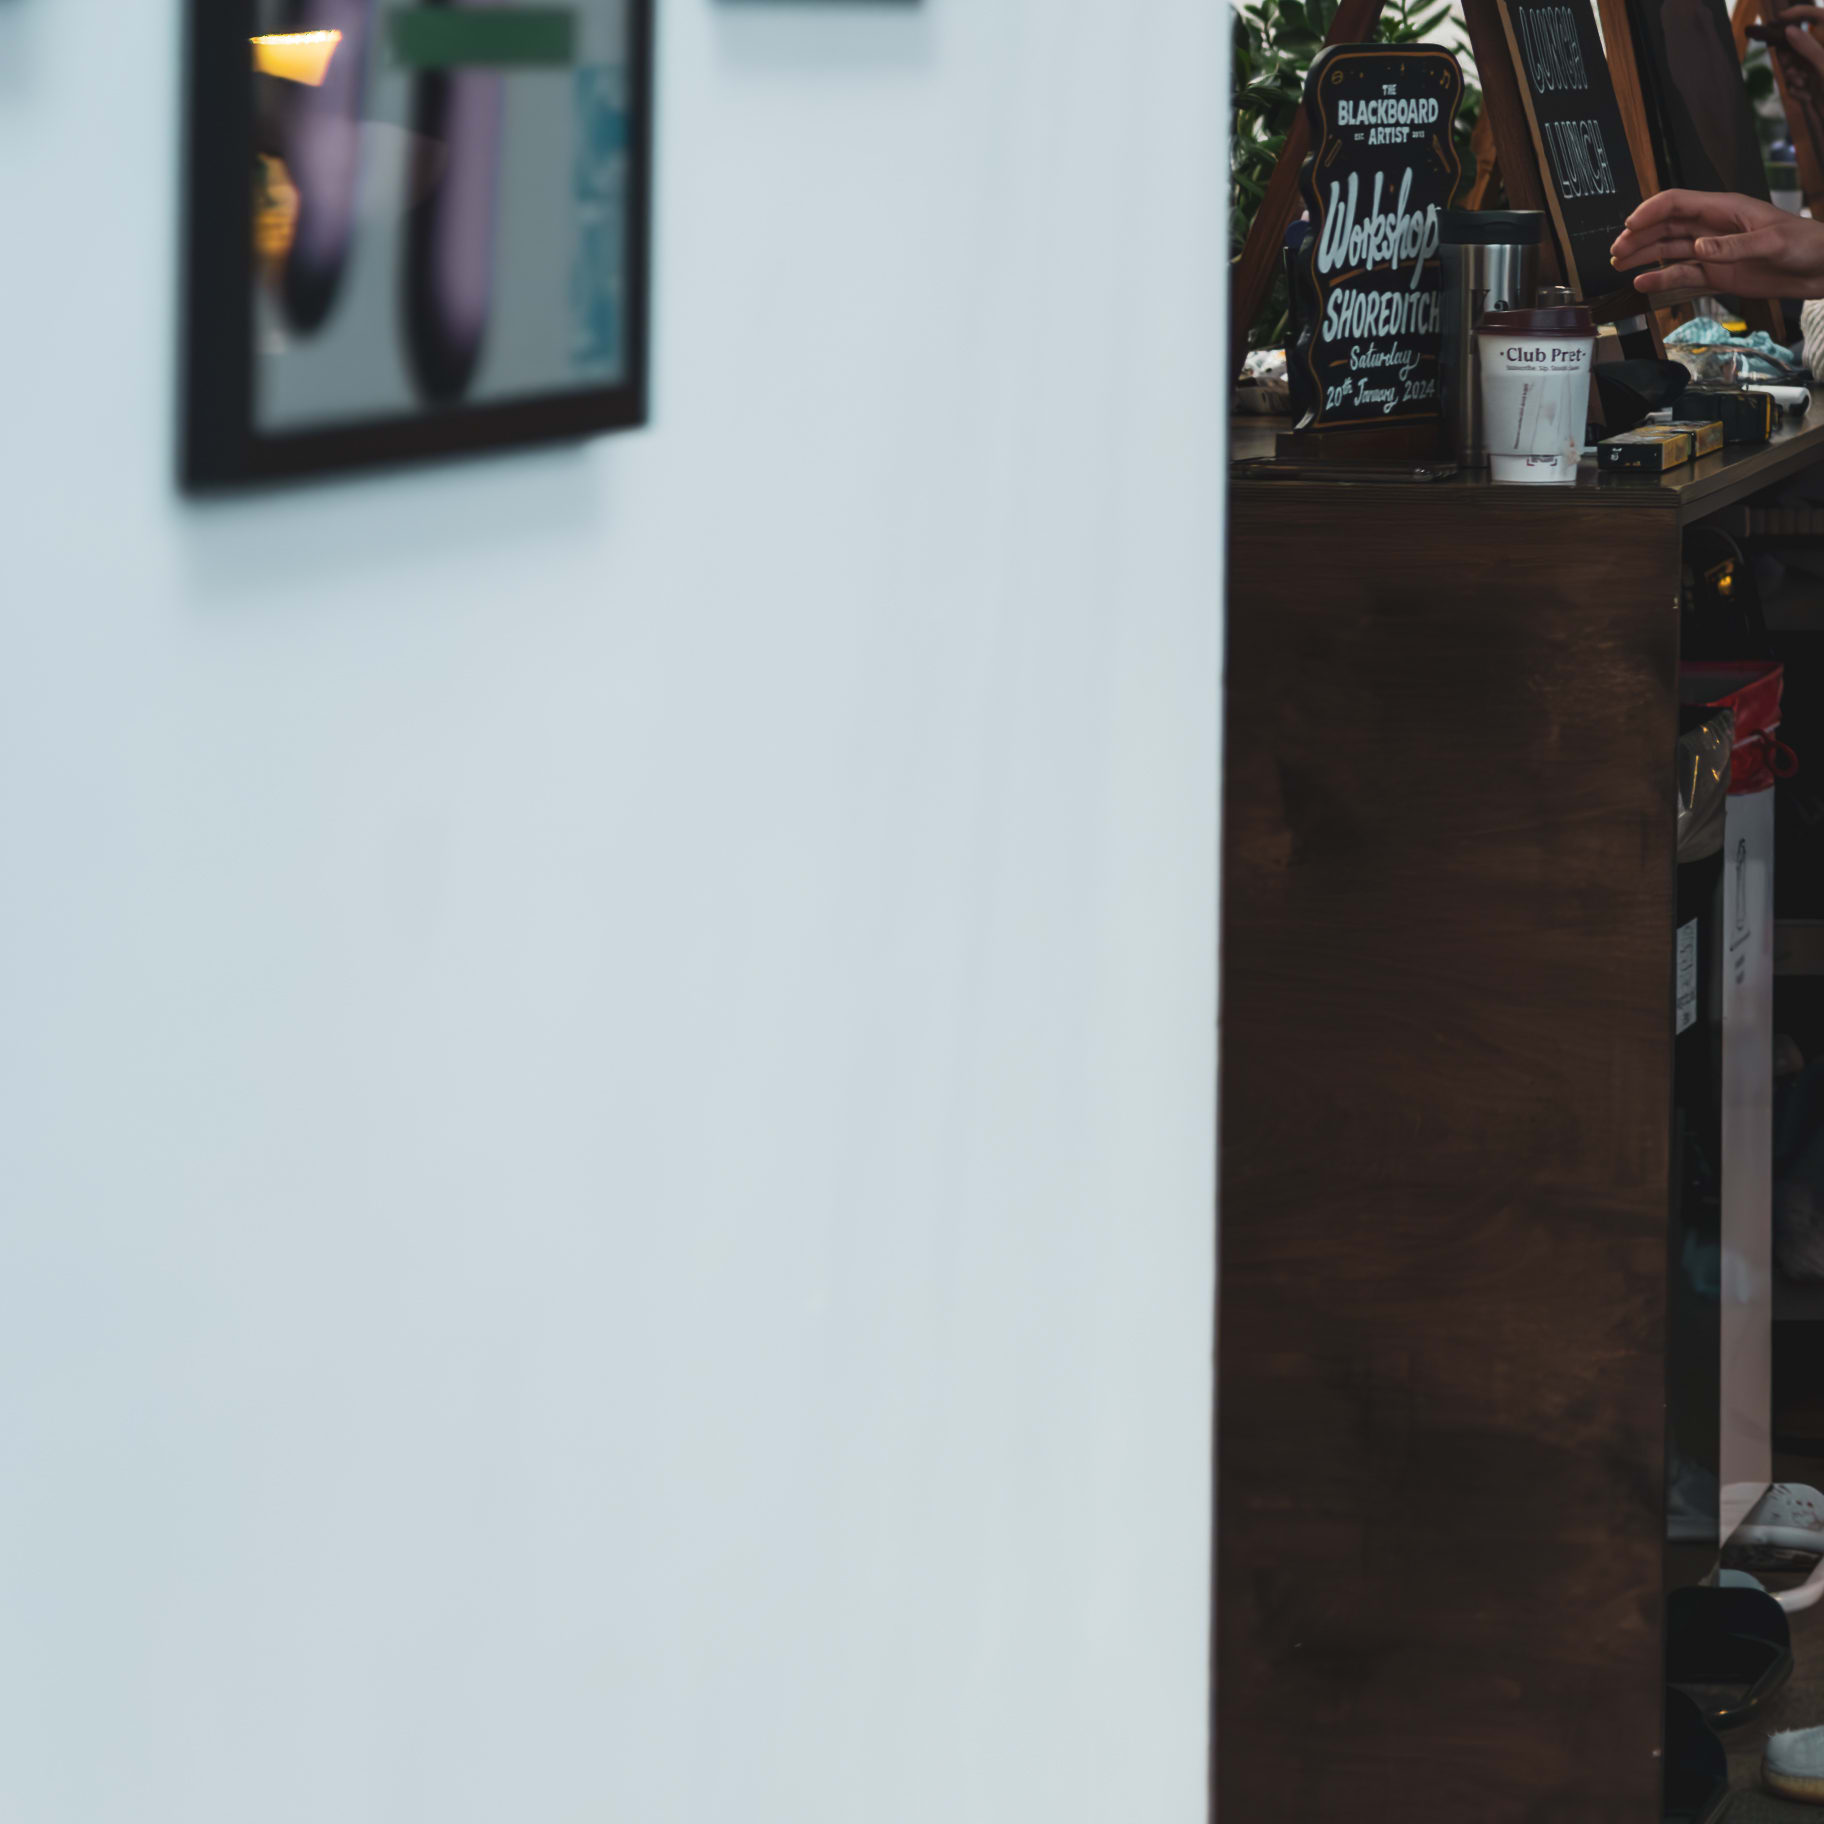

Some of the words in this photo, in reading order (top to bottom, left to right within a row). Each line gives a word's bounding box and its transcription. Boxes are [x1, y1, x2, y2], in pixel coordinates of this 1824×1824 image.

[1382, 83, 1398, 96] THE
[1337, 97, 1440, 126] BLACKBOARD
[1368, 126, 1411, 146] ARTIST
[1544, 120, 1616, 199] LUNCH
[1317, 166, 1441, 290] Workshop
[1322, 287, 1441, 343] SHOREDITCH
[1350, 341, 1421, 382] Saturday
[1506, 347, 1547, 363] Club
[1551, 348, 1583, 363] Pret
[1325, 377, 1353, 411] 20th
[1353, 377, 1399, 414] January
[1402, 379, 1436, 402] 2024
